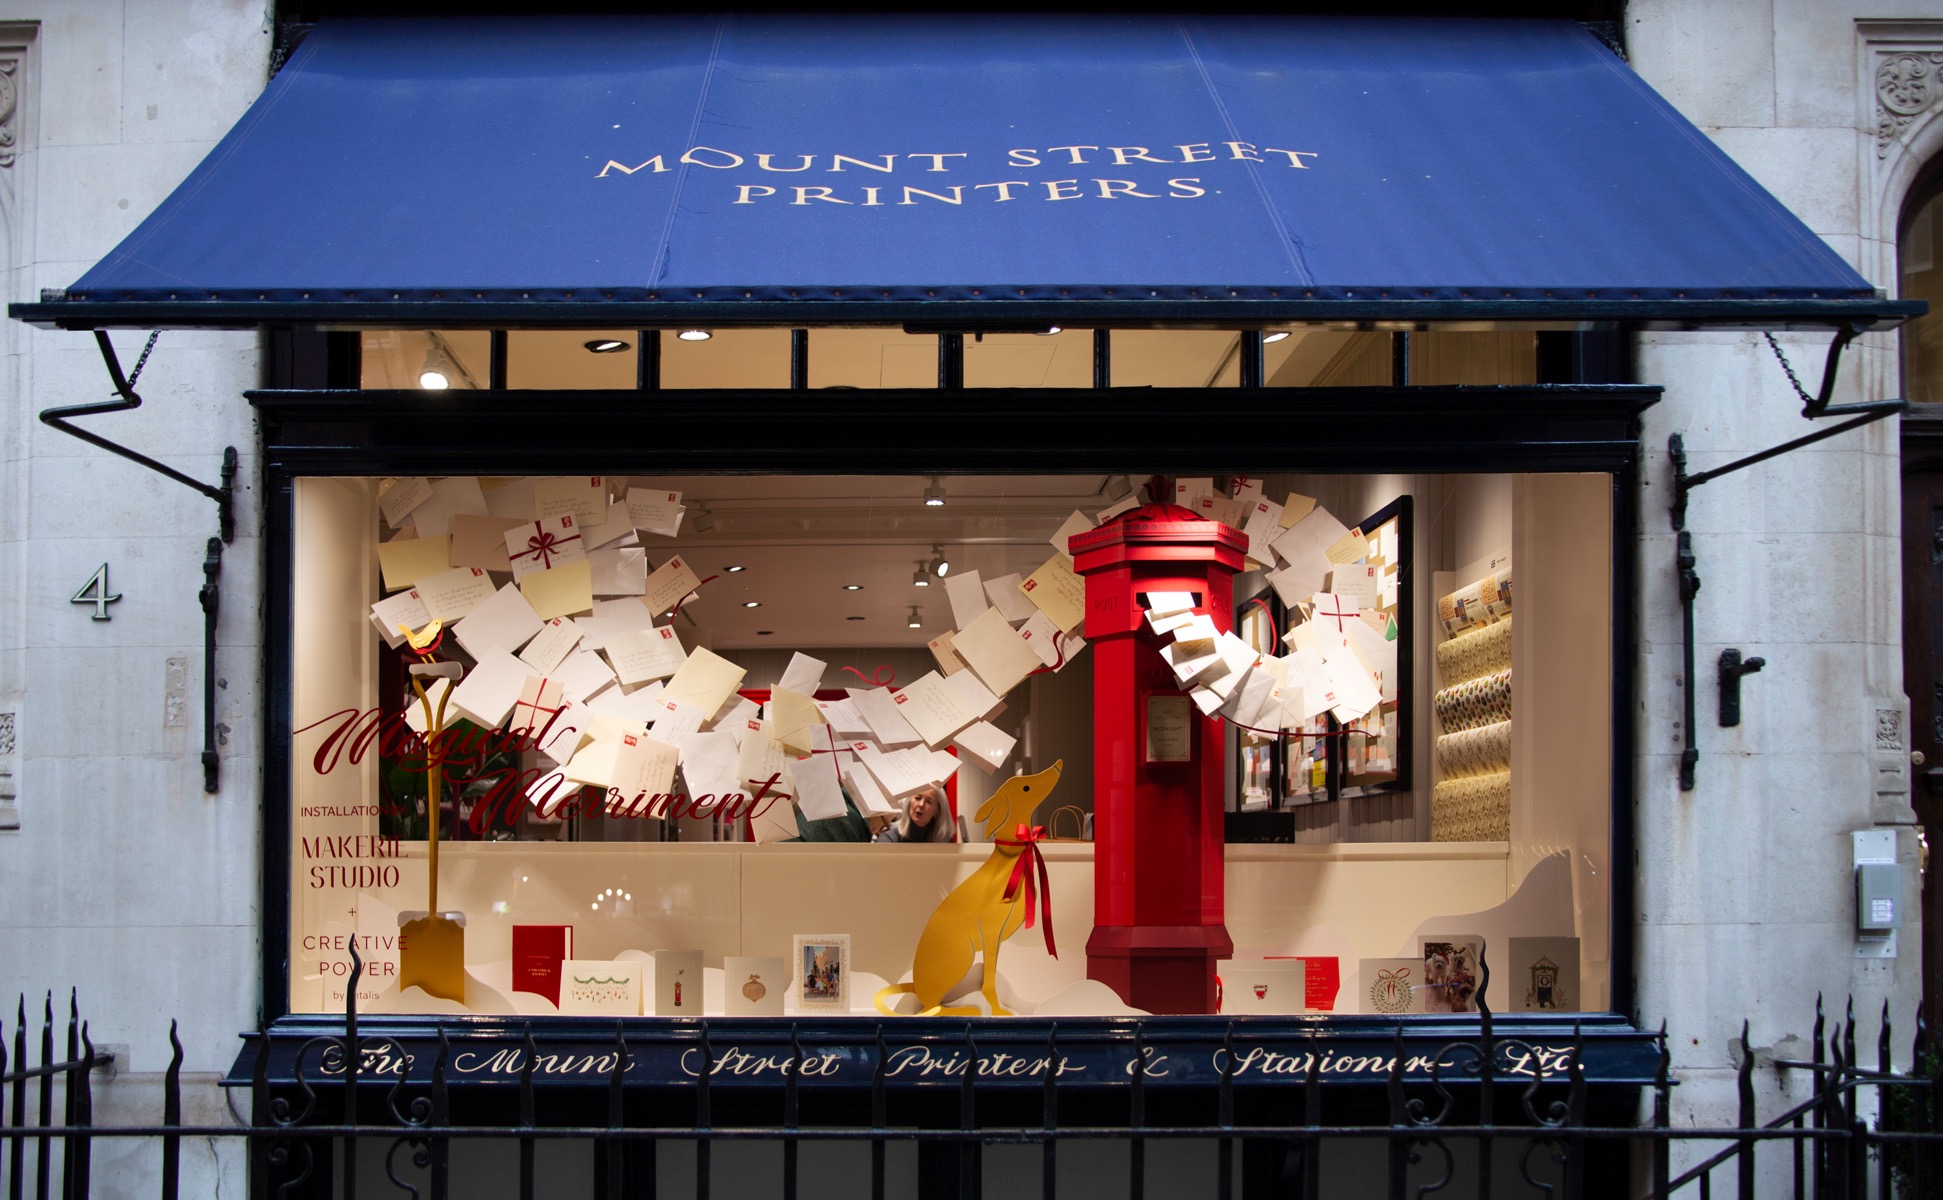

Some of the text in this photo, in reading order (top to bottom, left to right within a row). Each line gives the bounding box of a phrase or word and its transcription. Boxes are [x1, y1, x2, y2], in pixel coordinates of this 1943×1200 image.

[595, 140, 1318, 178] MOUNT STREET
[733, 177, 1206, 206] PRINTERS
[70, 562, 123, 621] 4
[1094, 595, 1119, 613] POST
[293, 705, 577, 774] Magical
[301, 805, 389, 817] INSTALLATION
[442, 767, 792, 834] Merriment
[302, 836, 408, 858] MAKERIE
[310, 864, 400, 889] STUDIO
[303, 935, 408, 951] CREATIVE
[319, 961, 395, 977] POWER
[333, 990, 380, 1002] by ntalis
[320, 1043, 415, 1074] The
[681, 1046, 842, 1076] Street
[884, 1045, 1086, 1077] Printers
[1125, 1046, 1169, 1077] &
